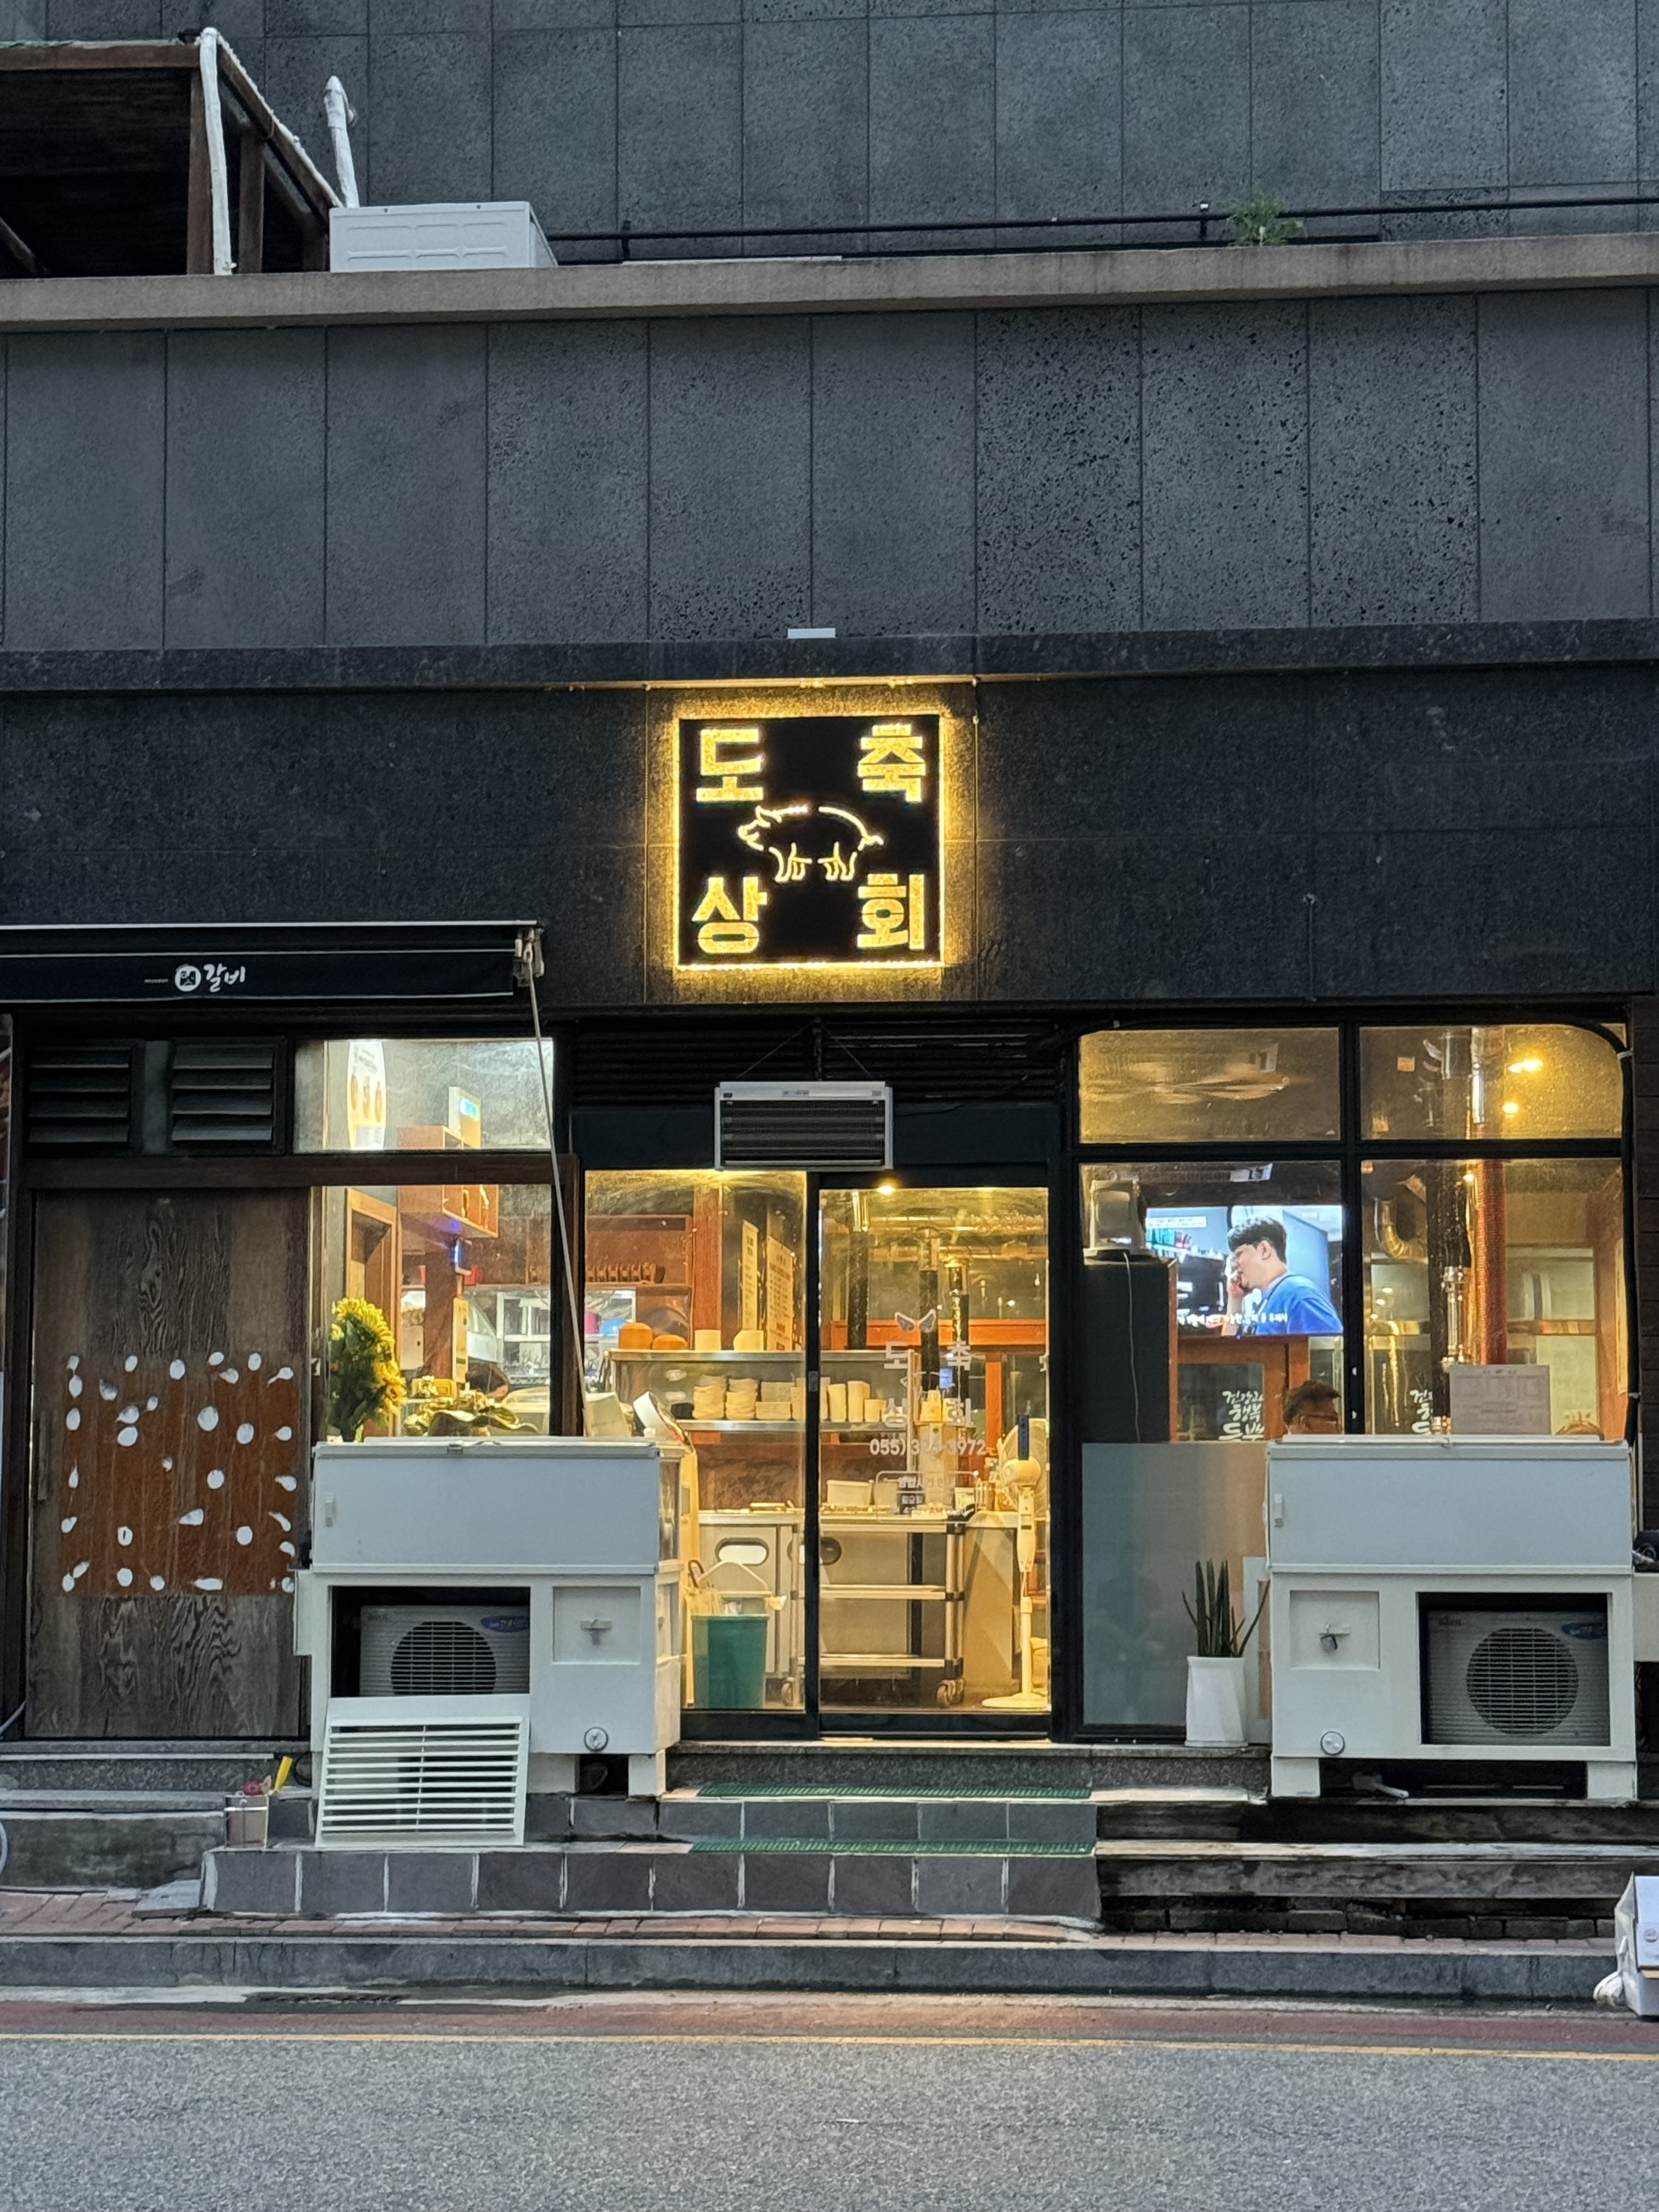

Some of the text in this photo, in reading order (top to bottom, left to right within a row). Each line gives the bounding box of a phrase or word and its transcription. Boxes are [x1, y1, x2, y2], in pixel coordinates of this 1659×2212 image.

[696, 723, 926, 803] 도 축
[691, 873, 925, 954] 상 회
[203, 963, 246, 992] 갈비
[883, 1340, 910, 1369] 도
